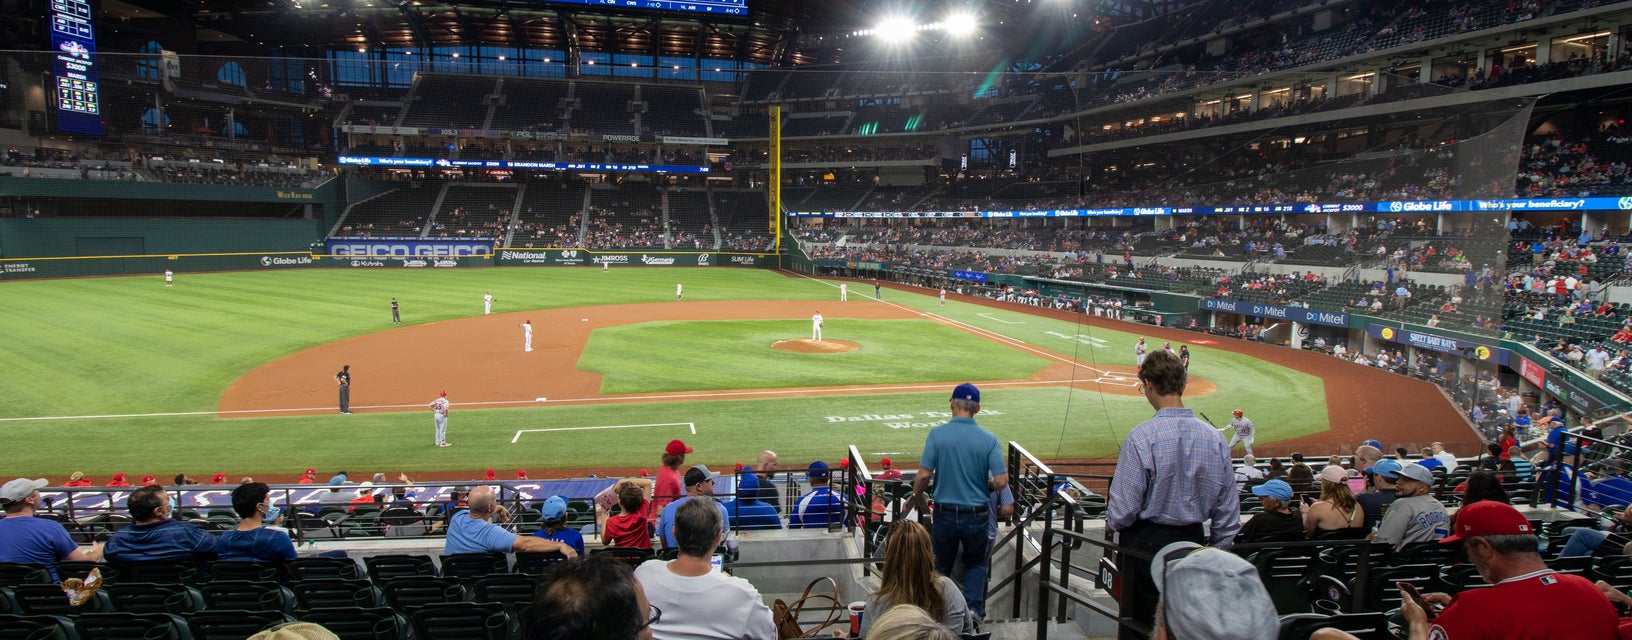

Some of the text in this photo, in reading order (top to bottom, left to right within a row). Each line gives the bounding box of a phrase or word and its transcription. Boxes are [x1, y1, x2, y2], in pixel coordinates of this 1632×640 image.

[66, 62, 87, 71] $3000
[1342, 204, 1364, 212] $3000
[1403, 201, 1452, 211] Globe Life
[1528, 200, 1585, 209] beneficiary?
[331, 244, 491, 260] GEICO GEICO
[273, 257, 297, 265] Globe
[1216, 301, 1236, 312] Mitel
[1264, 306, 1287, 317] Mitel
[1319, 312, 1345, 325] Mitel
[1409, 332, 1426, 344] SWEET
[1426, 335, 1440, 346] BABY
[1440, 338, 1457, 350] RAY'S
[824, 413, 914, 423] Dallas
[1102, 567, 1113, 589] 08
